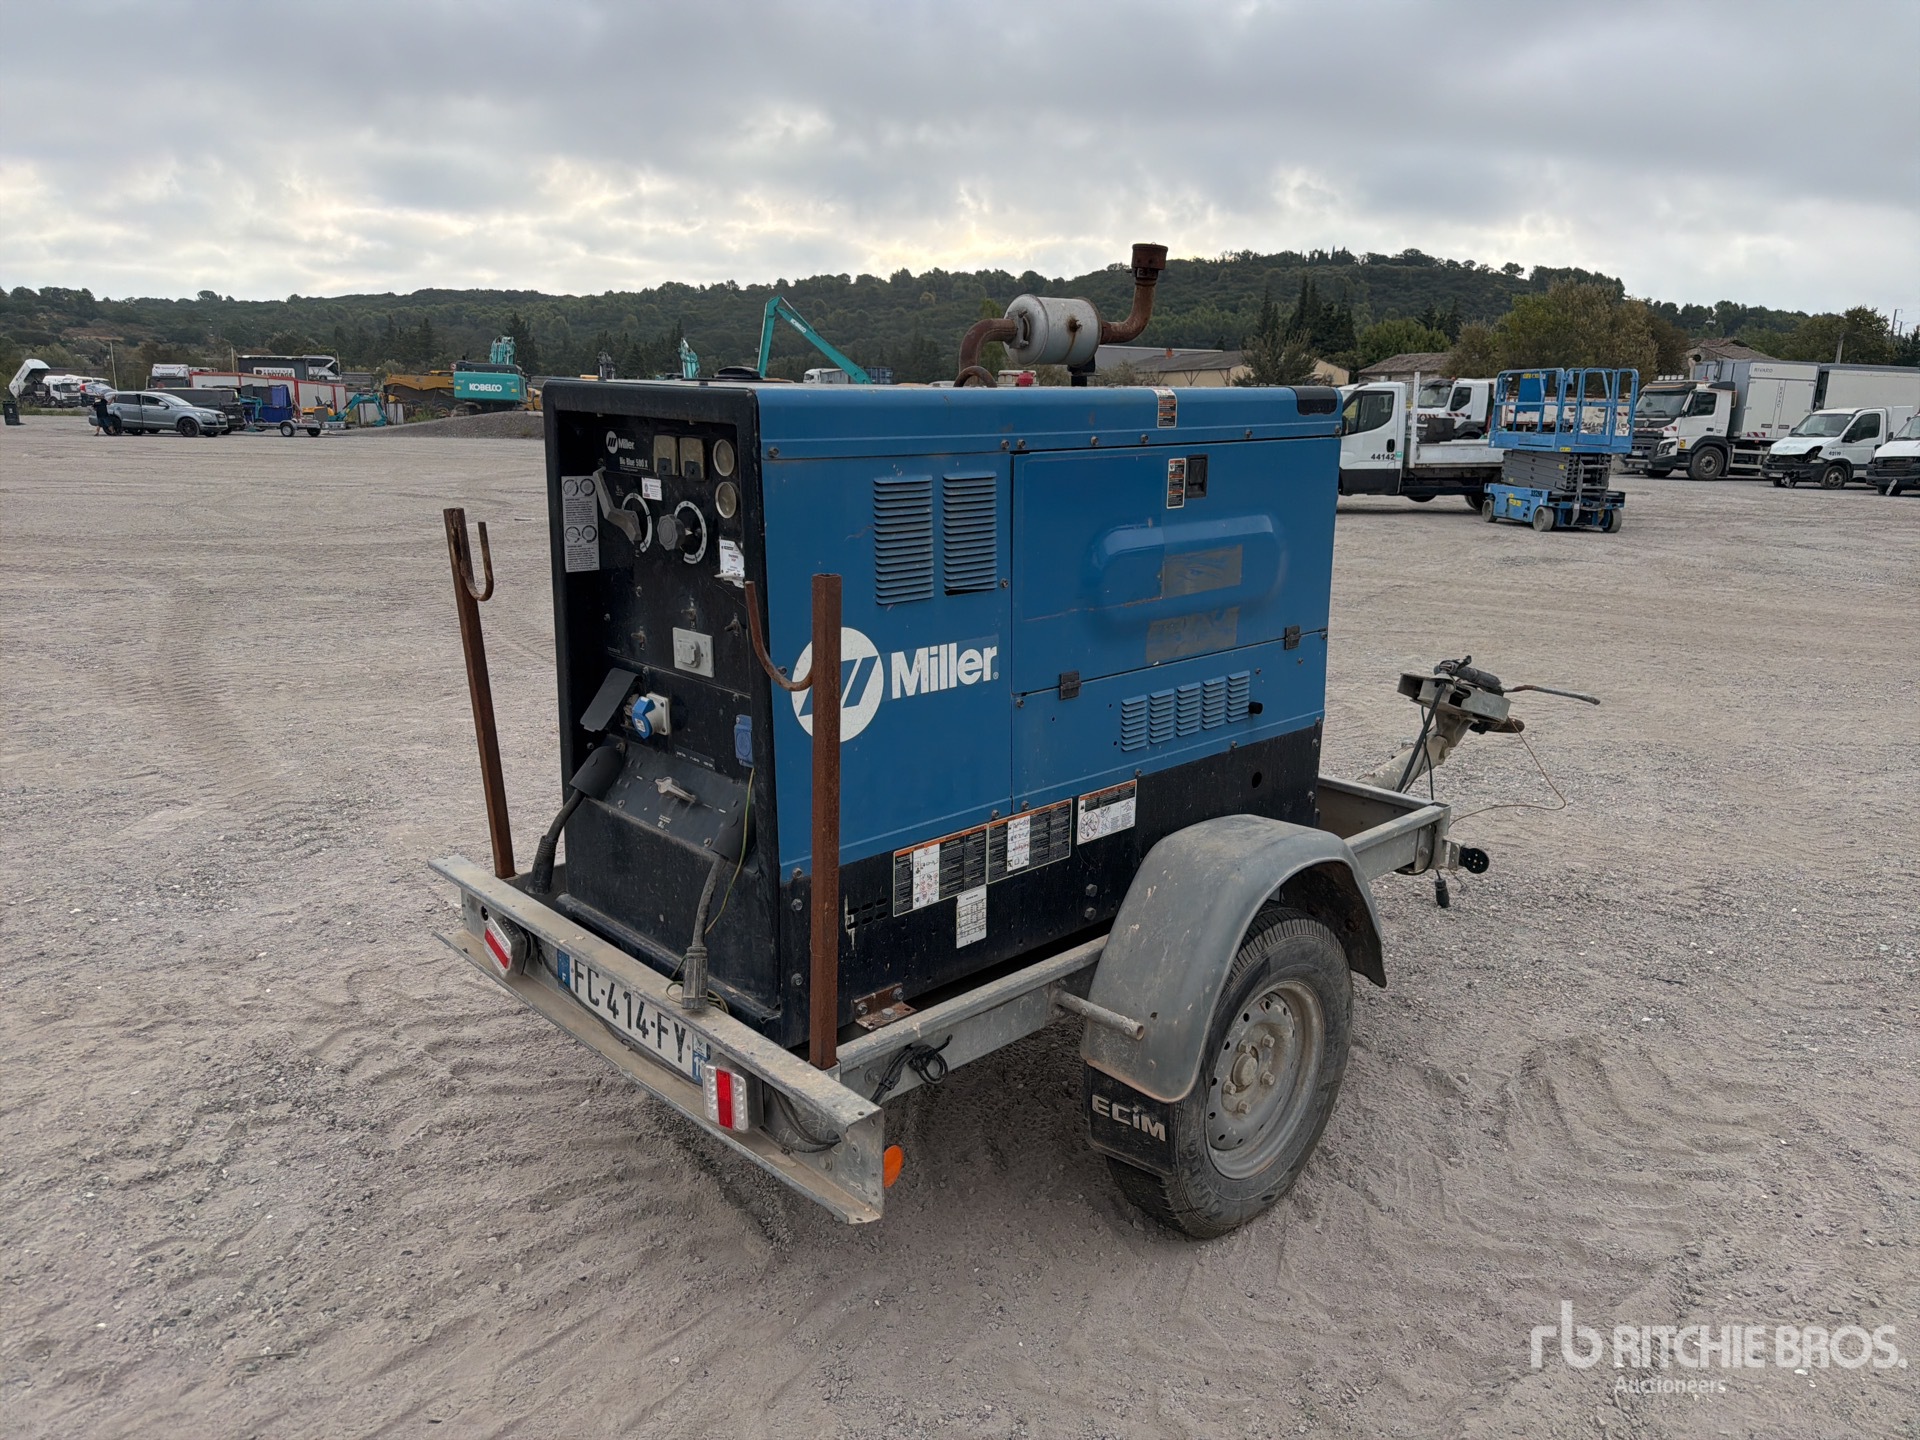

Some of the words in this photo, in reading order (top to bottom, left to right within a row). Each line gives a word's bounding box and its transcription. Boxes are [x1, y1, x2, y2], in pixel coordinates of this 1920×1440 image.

[469, 383, 502, 392] KOBELCO
[618, 438, 635, 449] Miller
[891, 642, 999, 700] Miller
[574, 959, 686, 1063] FC-414-FY
